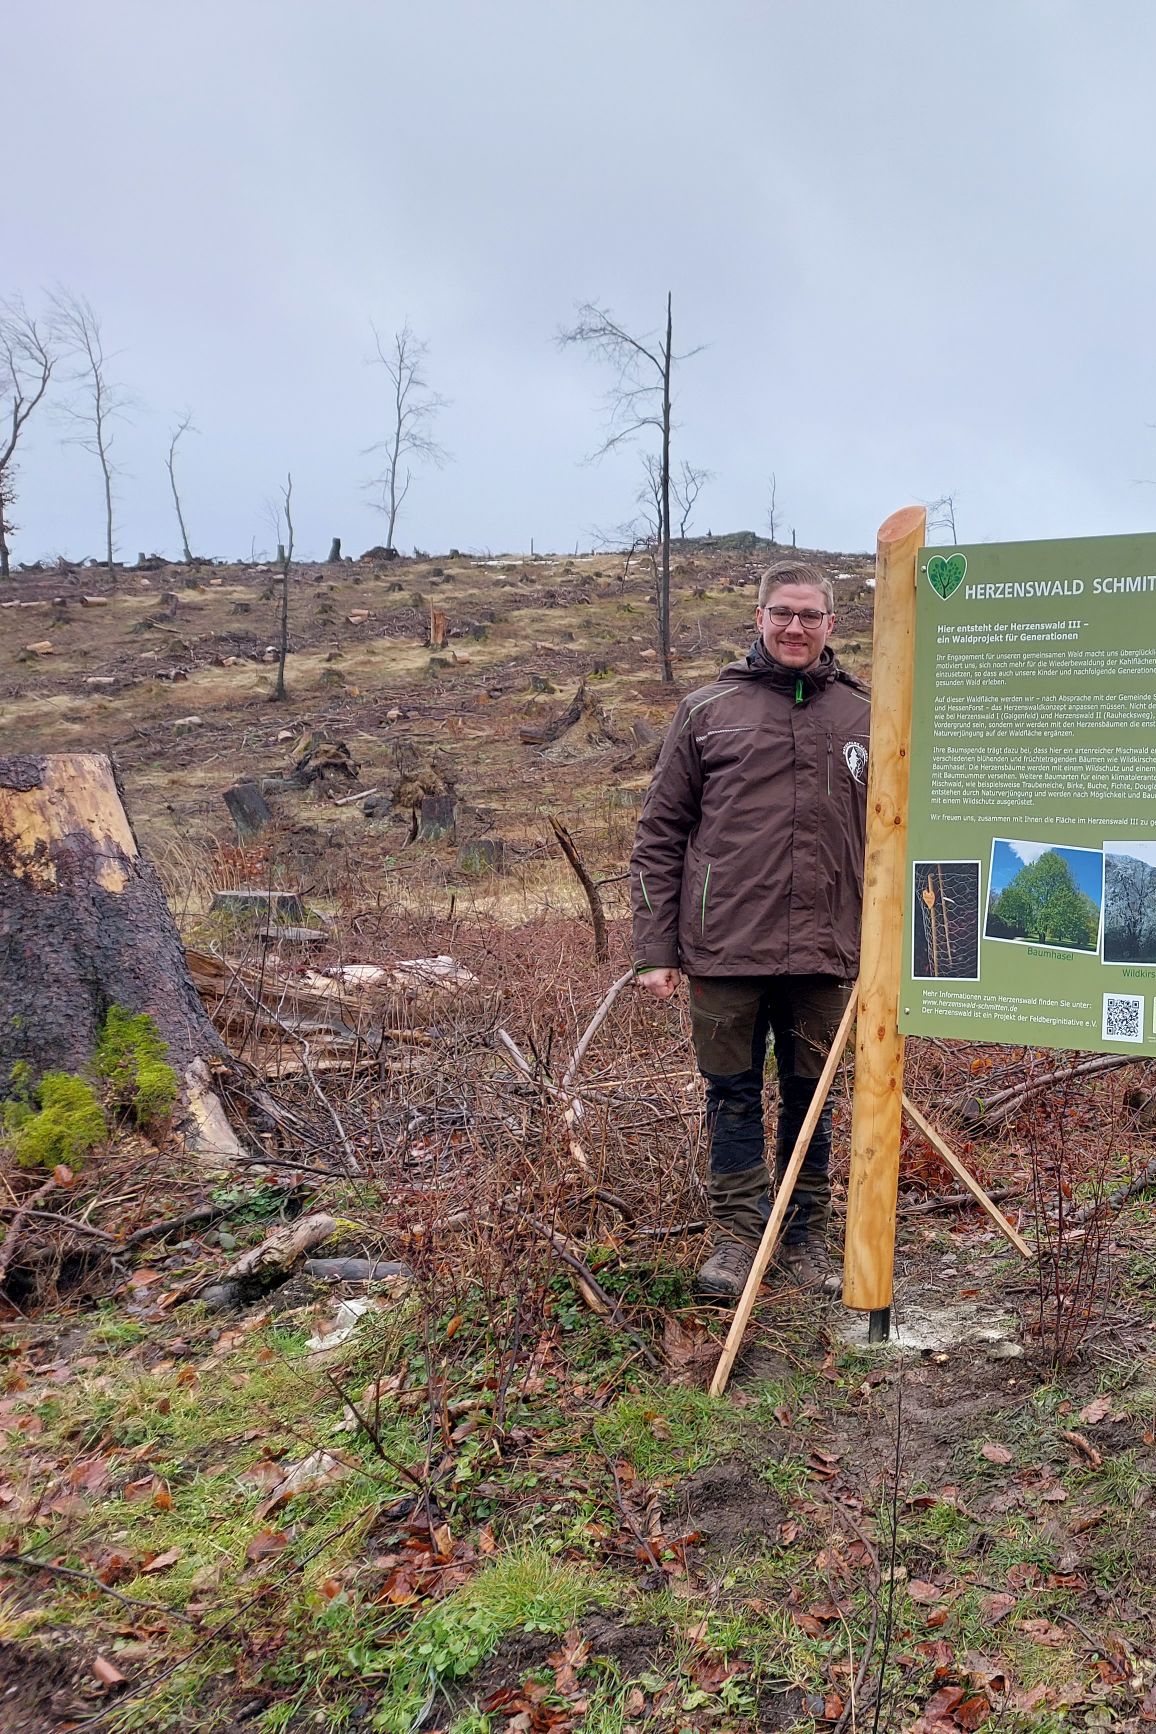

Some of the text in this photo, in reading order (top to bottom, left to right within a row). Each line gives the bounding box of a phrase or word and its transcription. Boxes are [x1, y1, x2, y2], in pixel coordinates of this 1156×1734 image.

[965, 578, 1084, 599] HERZENSWALD
[937, 619, 1080, 633] Hier entsteht der Herzenswald III
[936, 630, 1078, 645] ein Waldprojekt für Generationen
[947, 652, 984, 662] Engagement
[1048, 658, 1104, 668] Wiederbewaldung
[1119, 656, 1156, 664] Kahlflächen
[935, 670, 972, 679] einzusetzen,
[1073, 666, 1115, 676] nachfolgende
[935, 678, 964, 687] gesunden
[1058, 693, 1091, 702] Absprache
[1003, 702, 1066, 712] Herzenswaldkonzept
[933, 721, 970, 730] Vordergrund
[972, 721, 986, 729] sein,
[933, 729, 983, 738] Naturverjüngung
[1043, 728, 1074, 737] ergänzen.
[947, 746, 985, 755] Baumspende
[987, 746, 1001, 755] trägt
[1020, 746, 1031, 755] bei,
[977, 780, 1020, 789] beispielsweise
[1022, 781, 1064, 790] Traubeneiche,
[1066, 781, 1084, 790] Birke,
[1087, 781, 1108, 790] Buche,
[1111, 781, 1132, 790] Fichte,
[981, 789, 1032, 798] Naturverjüngung
[1090, 790, 1126, 799] Möglichkeit
[1087, 816, 1128, 824] Herzenswald
[1027, 946, 1074, 960] Baumhasel
[939, 990, 981, 1000] Informationen
[998, 994, 1037, 1004] Herzenswald
[1038, 997, 1058, 1006] finden
[1071, 1000, 1091, 1008] unter:
[934, 1007, 971, 1016] Herzenswald
[993, 1011, 1015, 1022] Projekt
[1029, 1014, 1083, 1027] Feldberginitiative
[1085, 1019, 1096, 1027] e.V.
